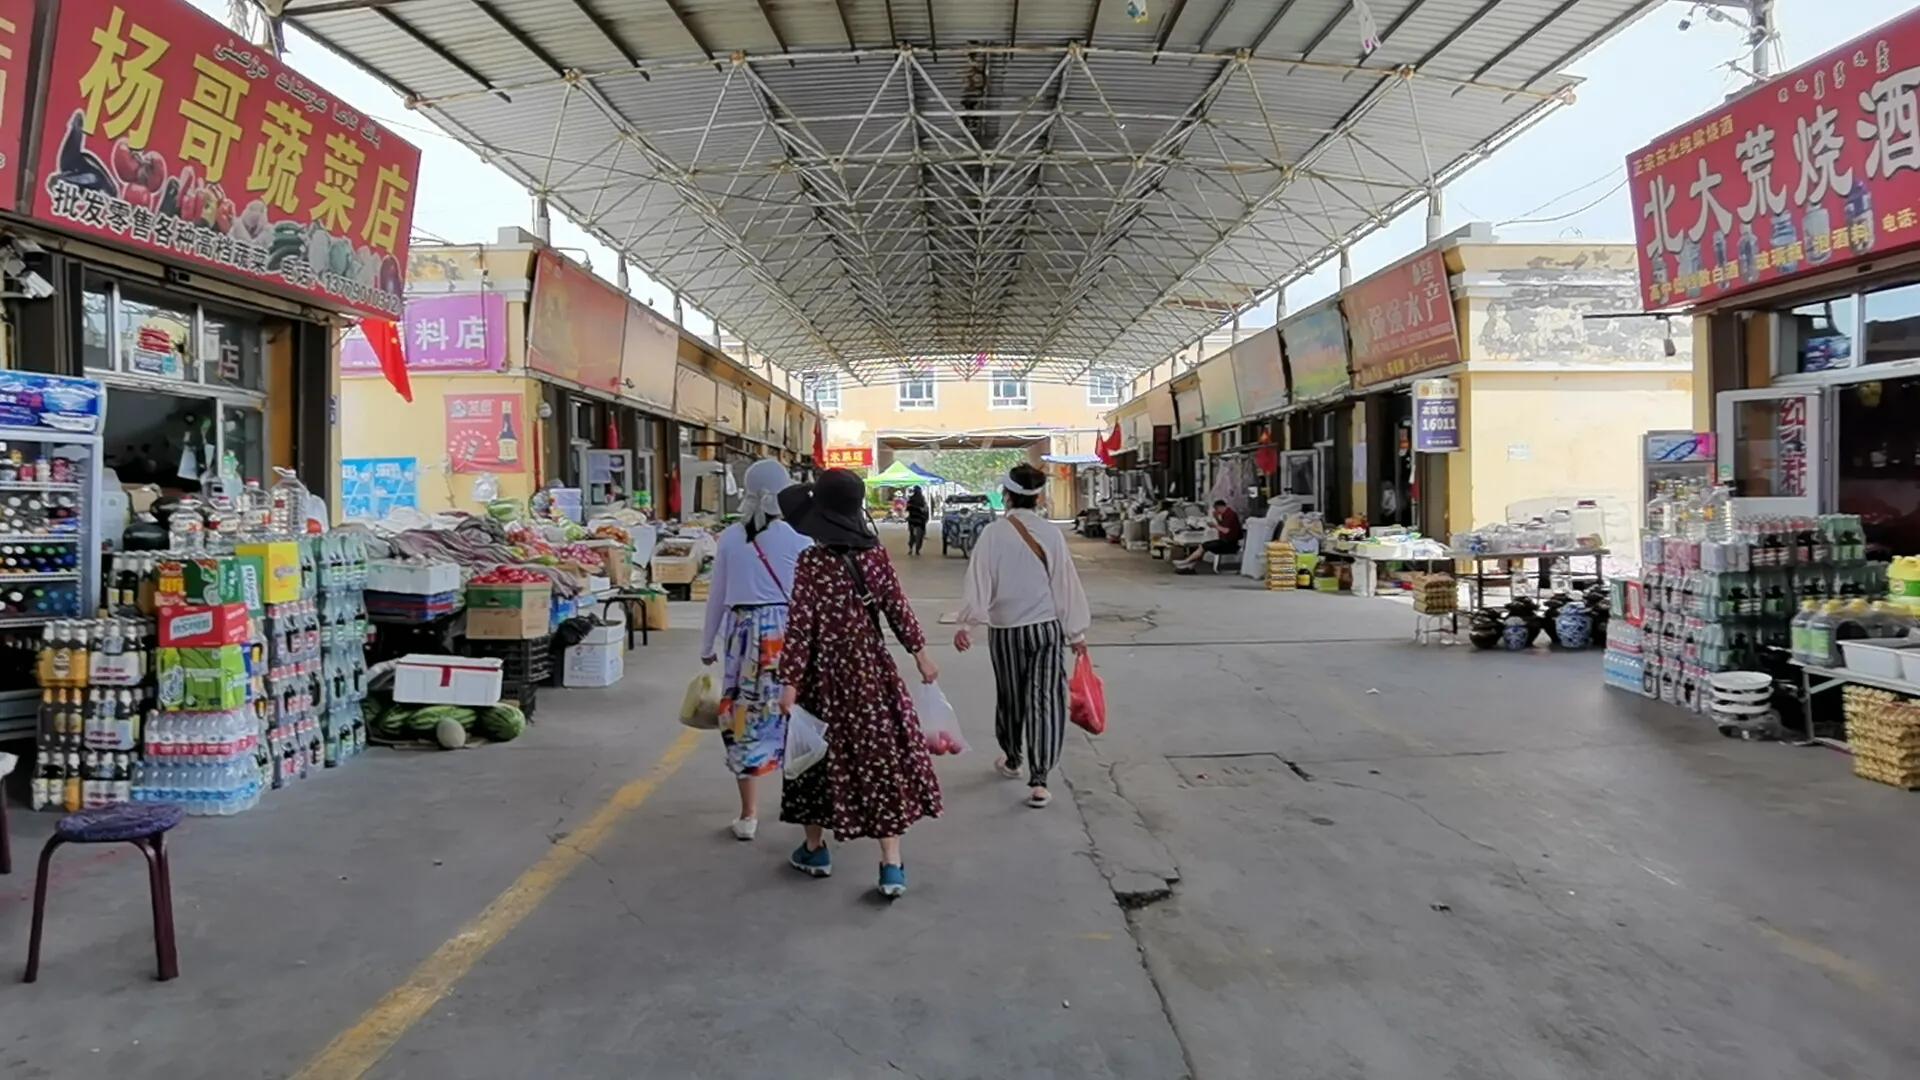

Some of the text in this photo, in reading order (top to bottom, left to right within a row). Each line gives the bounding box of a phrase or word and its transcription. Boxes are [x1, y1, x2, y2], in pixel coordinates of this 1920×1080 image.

[79, 5, 410, 255] 杨哥蔬菜店
[1643, 66, 1920, 260] 北大荒烧酒
[52, 182, 269, 274] 批发零售各种高档蔬菜
